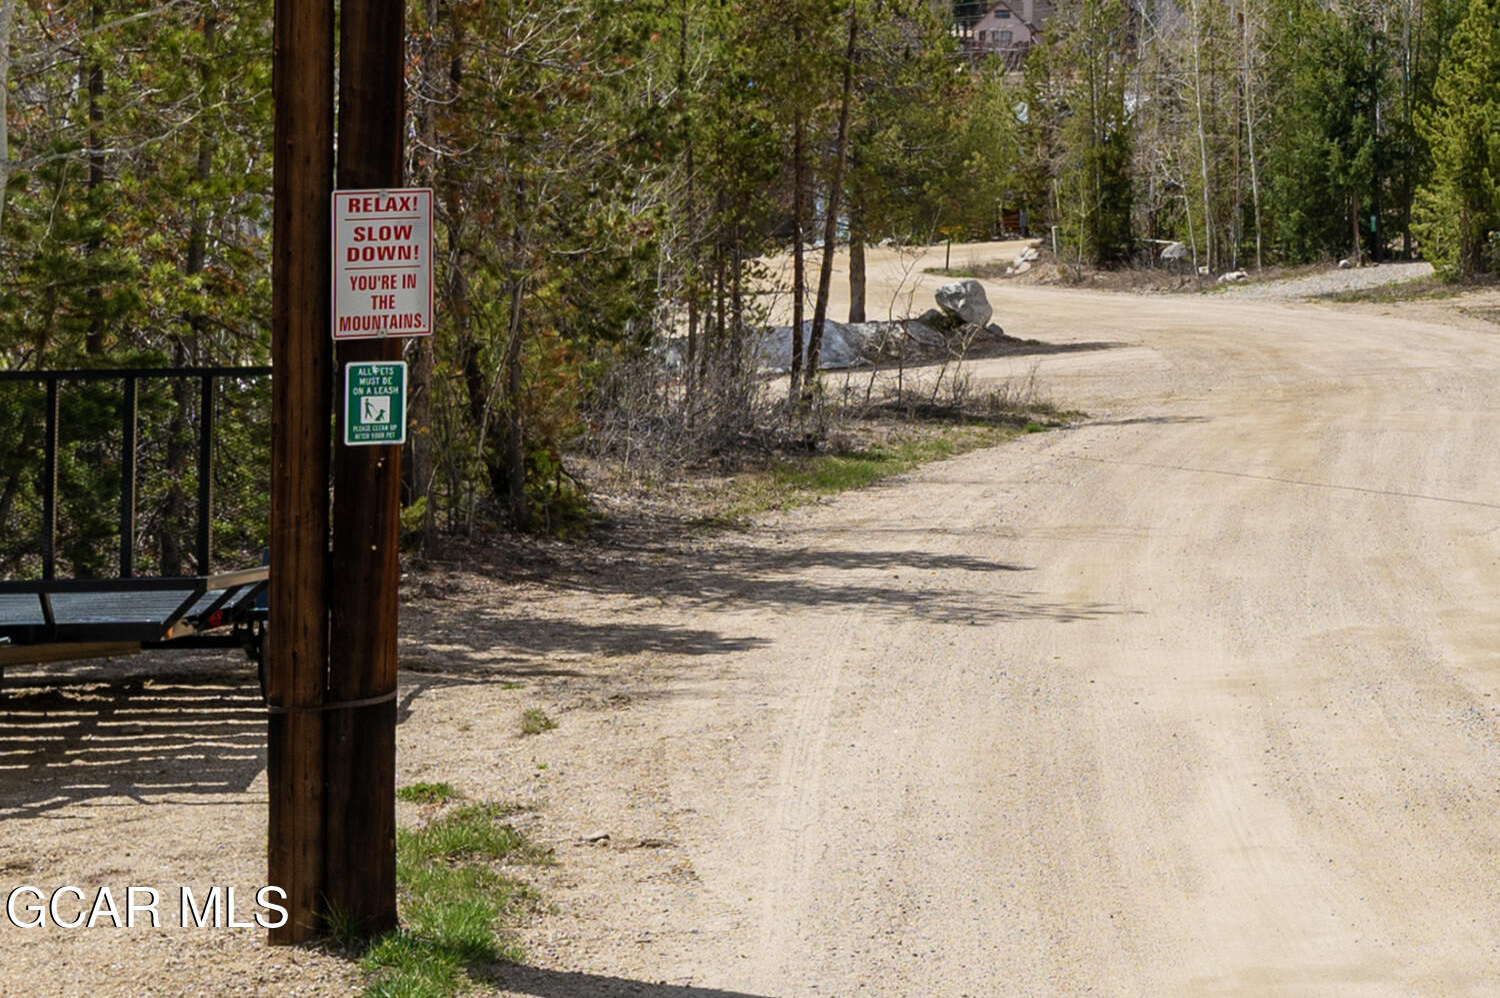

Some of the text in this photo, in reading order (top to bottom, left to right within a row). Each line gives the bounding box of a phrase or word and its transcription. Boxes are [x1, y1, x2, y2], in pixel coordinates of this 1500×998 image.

[348, 196, 418, 213] RELAX!
[353, 225, 413, 242] SLOW
[346, 245, 419, 262] DOWN!
[350, 273, 416, 291] YOU'RE IN
[371, 295, 395, 310] THE
[339, 313, 426, 331] MOUNTAINS.
[358, 368, 372, 376] ALL
[359, 377, 393, 386] MUST BE
[352, 386, 399, 396] ON A LEASH
